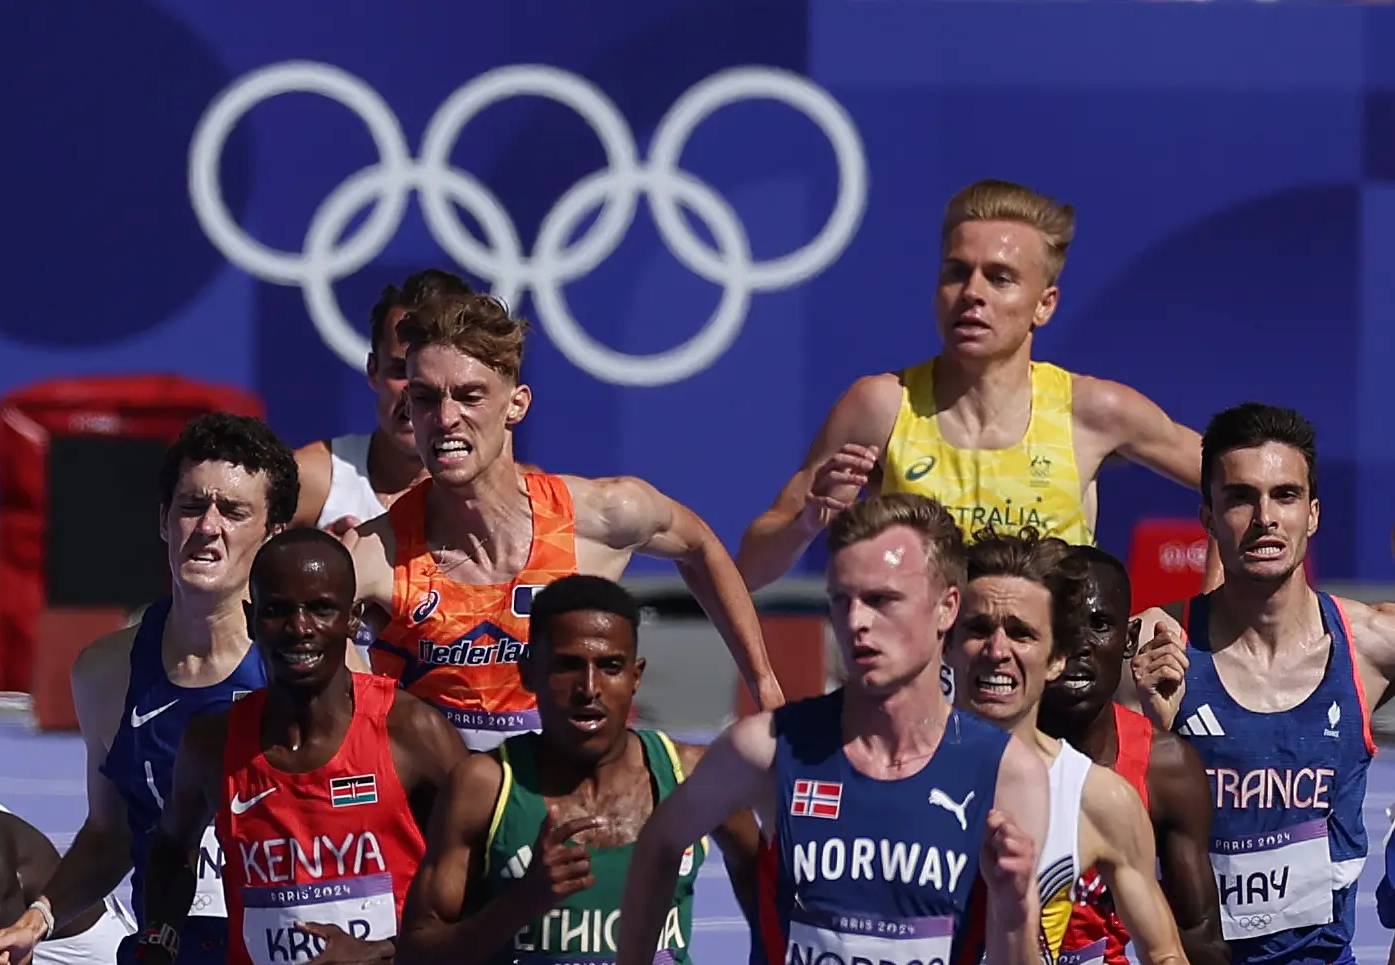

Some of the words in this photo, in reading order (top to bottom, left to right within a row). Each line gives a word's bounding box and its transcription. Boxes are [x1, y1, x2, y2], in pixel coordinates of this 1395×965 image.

[943, 506, 1041, 527] TRALIA
[447, 711, 483, 725] PARIS
[489, 715, 524, 727] 2024
[1215, 838, 1253, 850] PARIS
[1258, 833, 1291, 848] 2024
[239, 831, 386, 883] KENYA
[793, 837, 968, 893] NORWAY
[270, 889, 310, 902] PARIS
[313, 884, 351, 898] 2024
[1219, 866, 1289, 906] HAY
[877, 921, 915, 936] 2024
